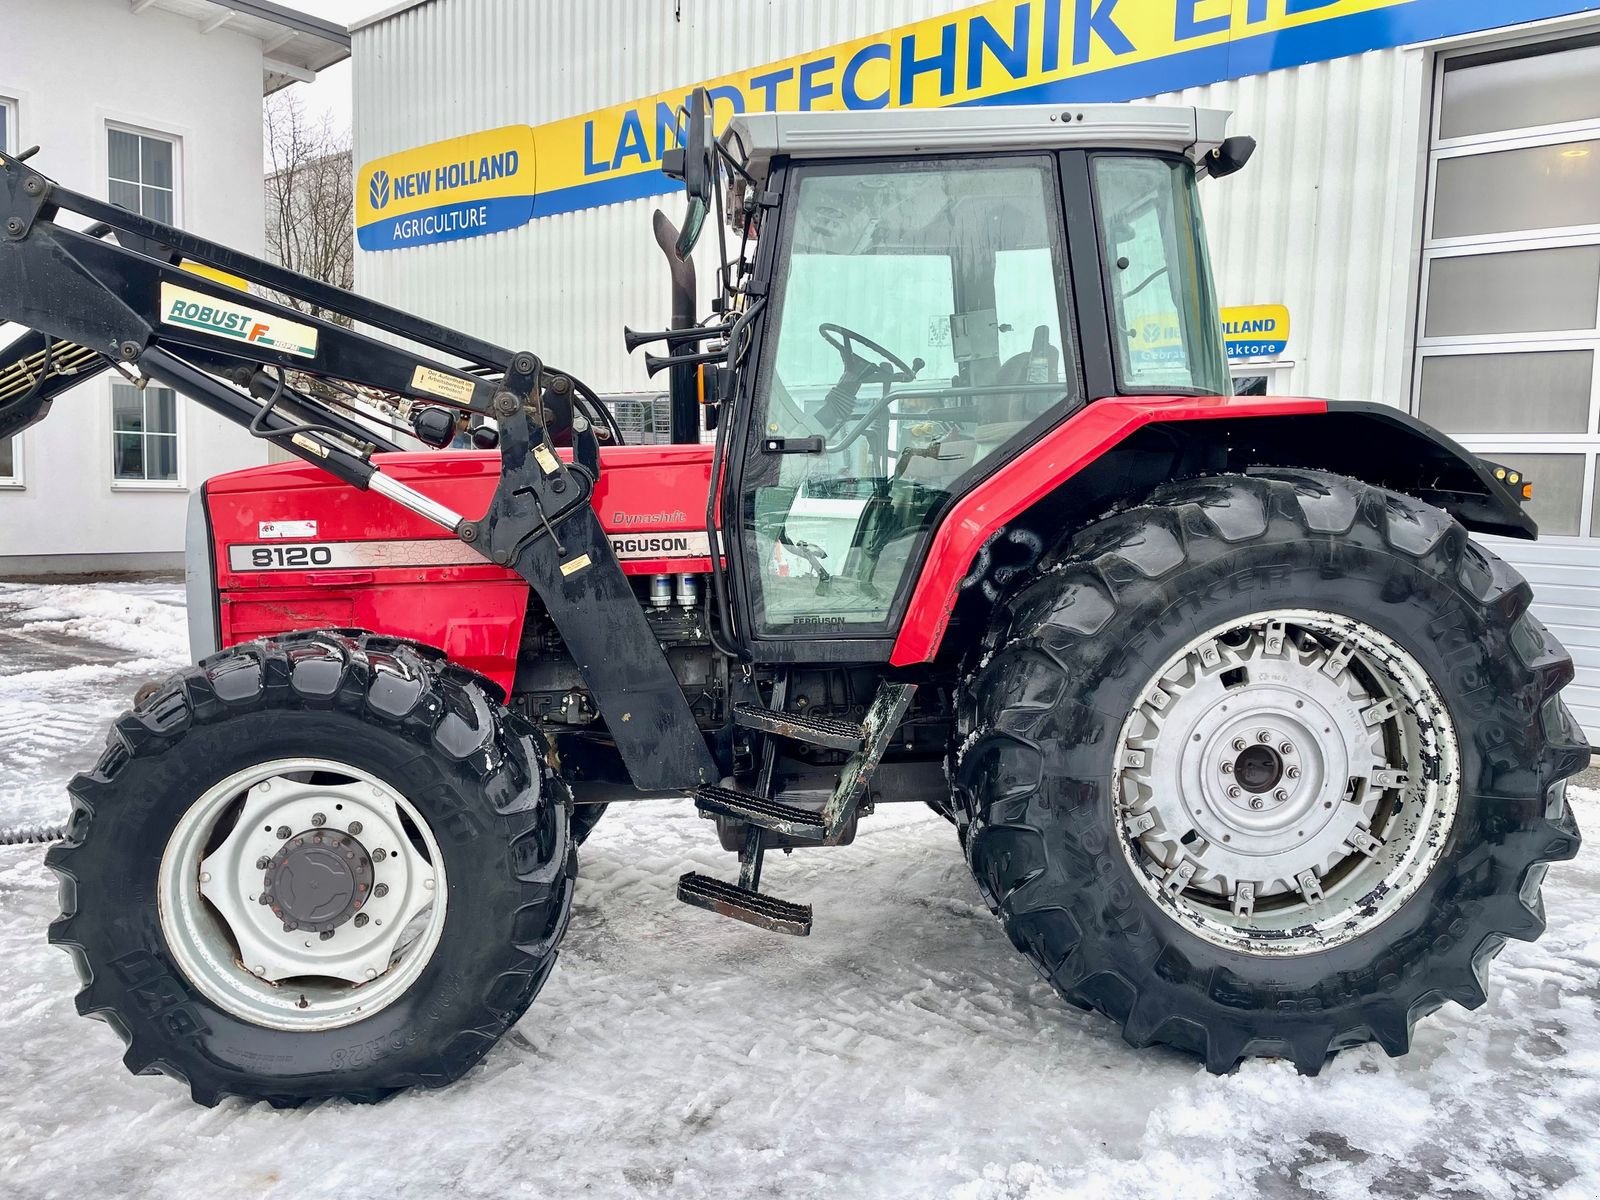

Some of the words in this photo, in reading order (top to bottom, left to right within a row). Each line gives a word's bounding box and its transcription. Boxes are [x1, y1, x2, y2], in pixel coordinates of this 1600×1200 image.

[393, 170, 432, 200] NEW
[435, 150, 519, 191] HOLLAND
[393, 206, 487, 241] AGRICULTURE
[170, 299, 252, 331] ROBUST
[248, 323, 270, 342] F
[1222, 318, 1276, 335] LLAND
[1227, 343, 1276, 357] aktore
[612, 510, 686, 527] Dynashift
[609, 538, 688, 554] RGUSON
[251, 546, 332, 567] 8120
[793, 616, 846, 626] FERGUSON
